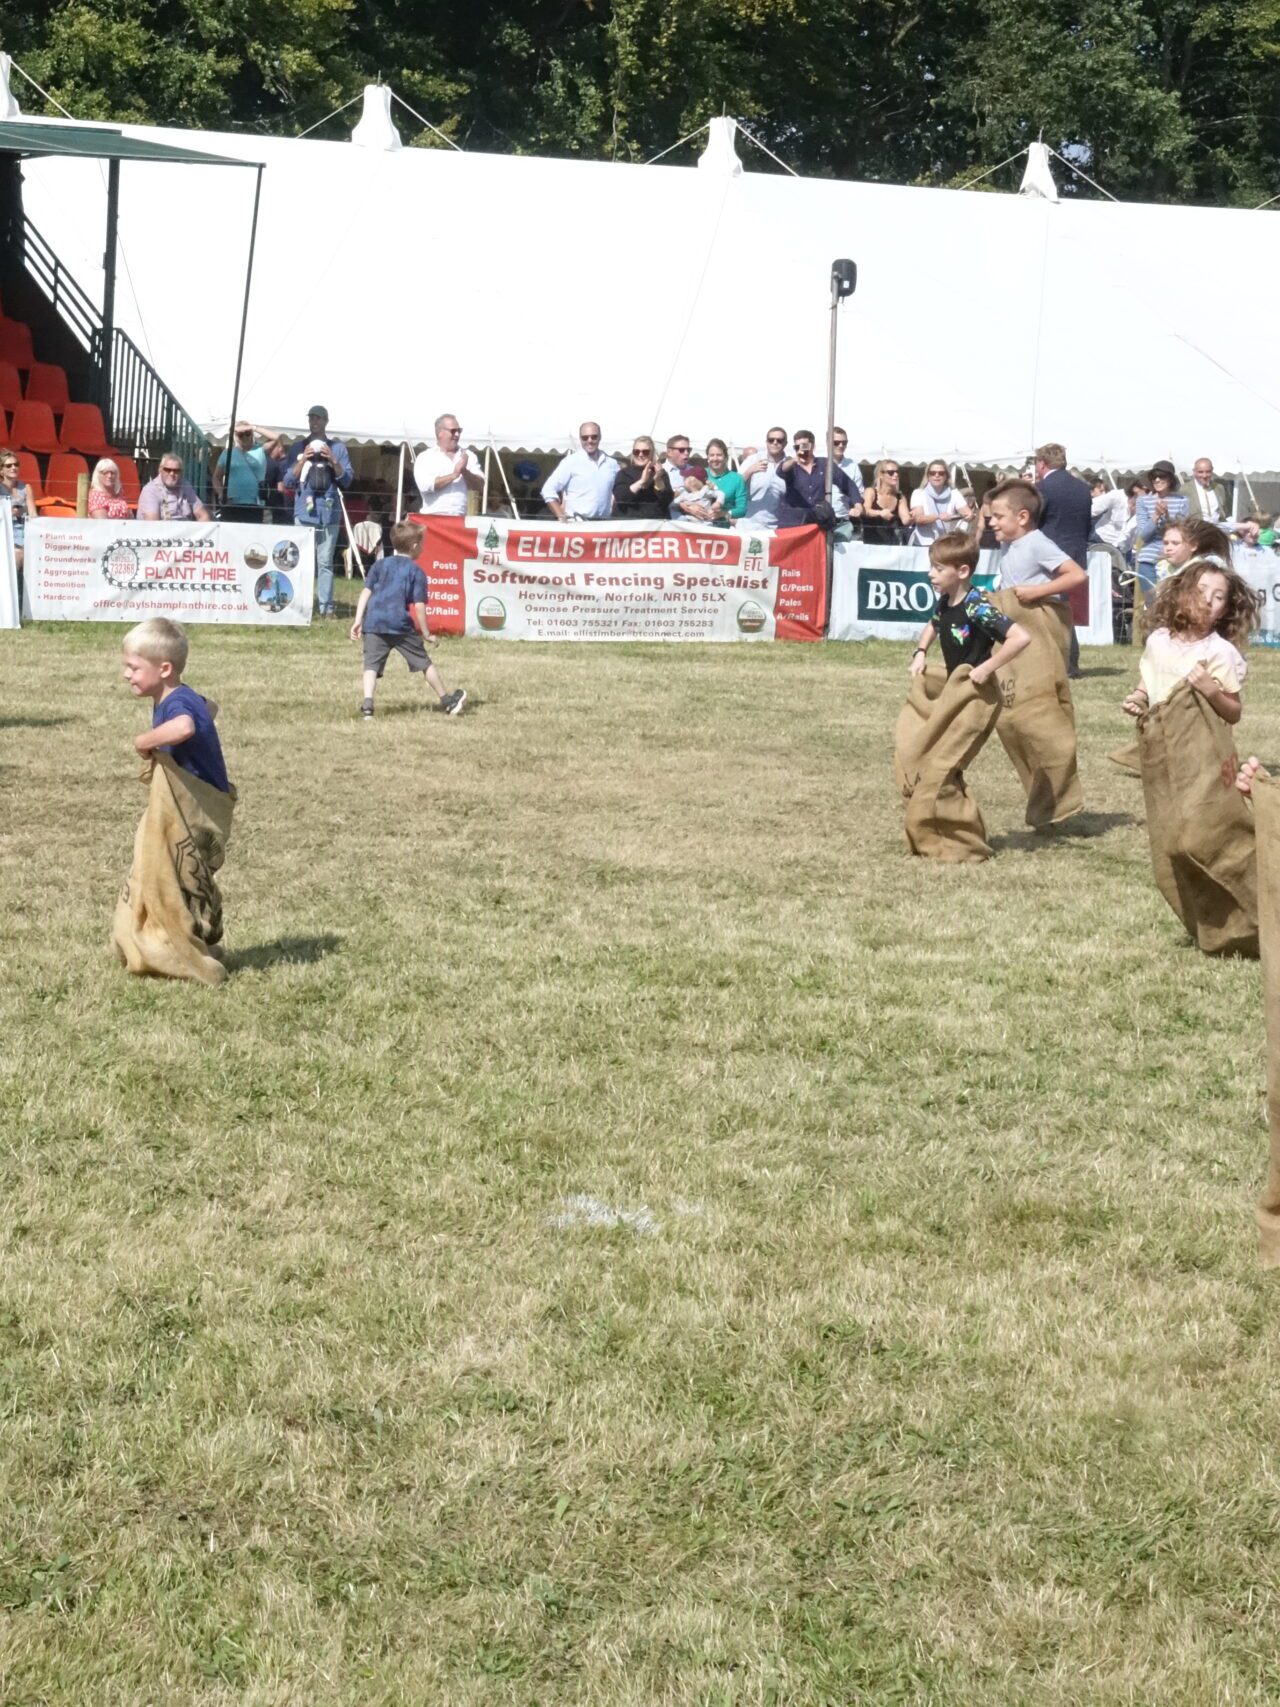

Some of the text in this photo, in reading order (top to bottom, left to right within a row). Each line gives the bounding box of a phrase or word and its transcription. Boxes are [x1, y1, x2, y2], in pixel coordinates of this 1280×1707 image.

[45, 533, 83, 541] Plant and
[44, 543, 72, 552] Digger
[517, 536, 729, 560] ELLIS TIMBER LTD
[44, 555, 96, 564] Groundworks
[153, 549, 229, 564] AYLSHAM
[432, 561, 458, 570] Posts
[744, 557, 763, 571] ETL
[44, 568, 89, 577] Aggregates
[144, 567, 237, 581] PLANT HIRE
[781, 569, 801, 577] Rails
[473, 569, 768, 590] Softwood Fencing Specialist
[43, 581, 86, 589] Demolition
[780, 584, 814, 592] G/Posts
[519, 590, 726, 603] Hevingham, Norfolk, NR10 5LX
[93, 600, 249, 612] office@aylshamplanthire.co.uk
[779, 599, 802, 607] Pales
[425, 607, 460, 616] C/Rails
[524, 604, 719, 614] Osmose Pressure Treatment Service
[547, 619, 578, 627] 01603
[582, 619, 618, 627] 755321
